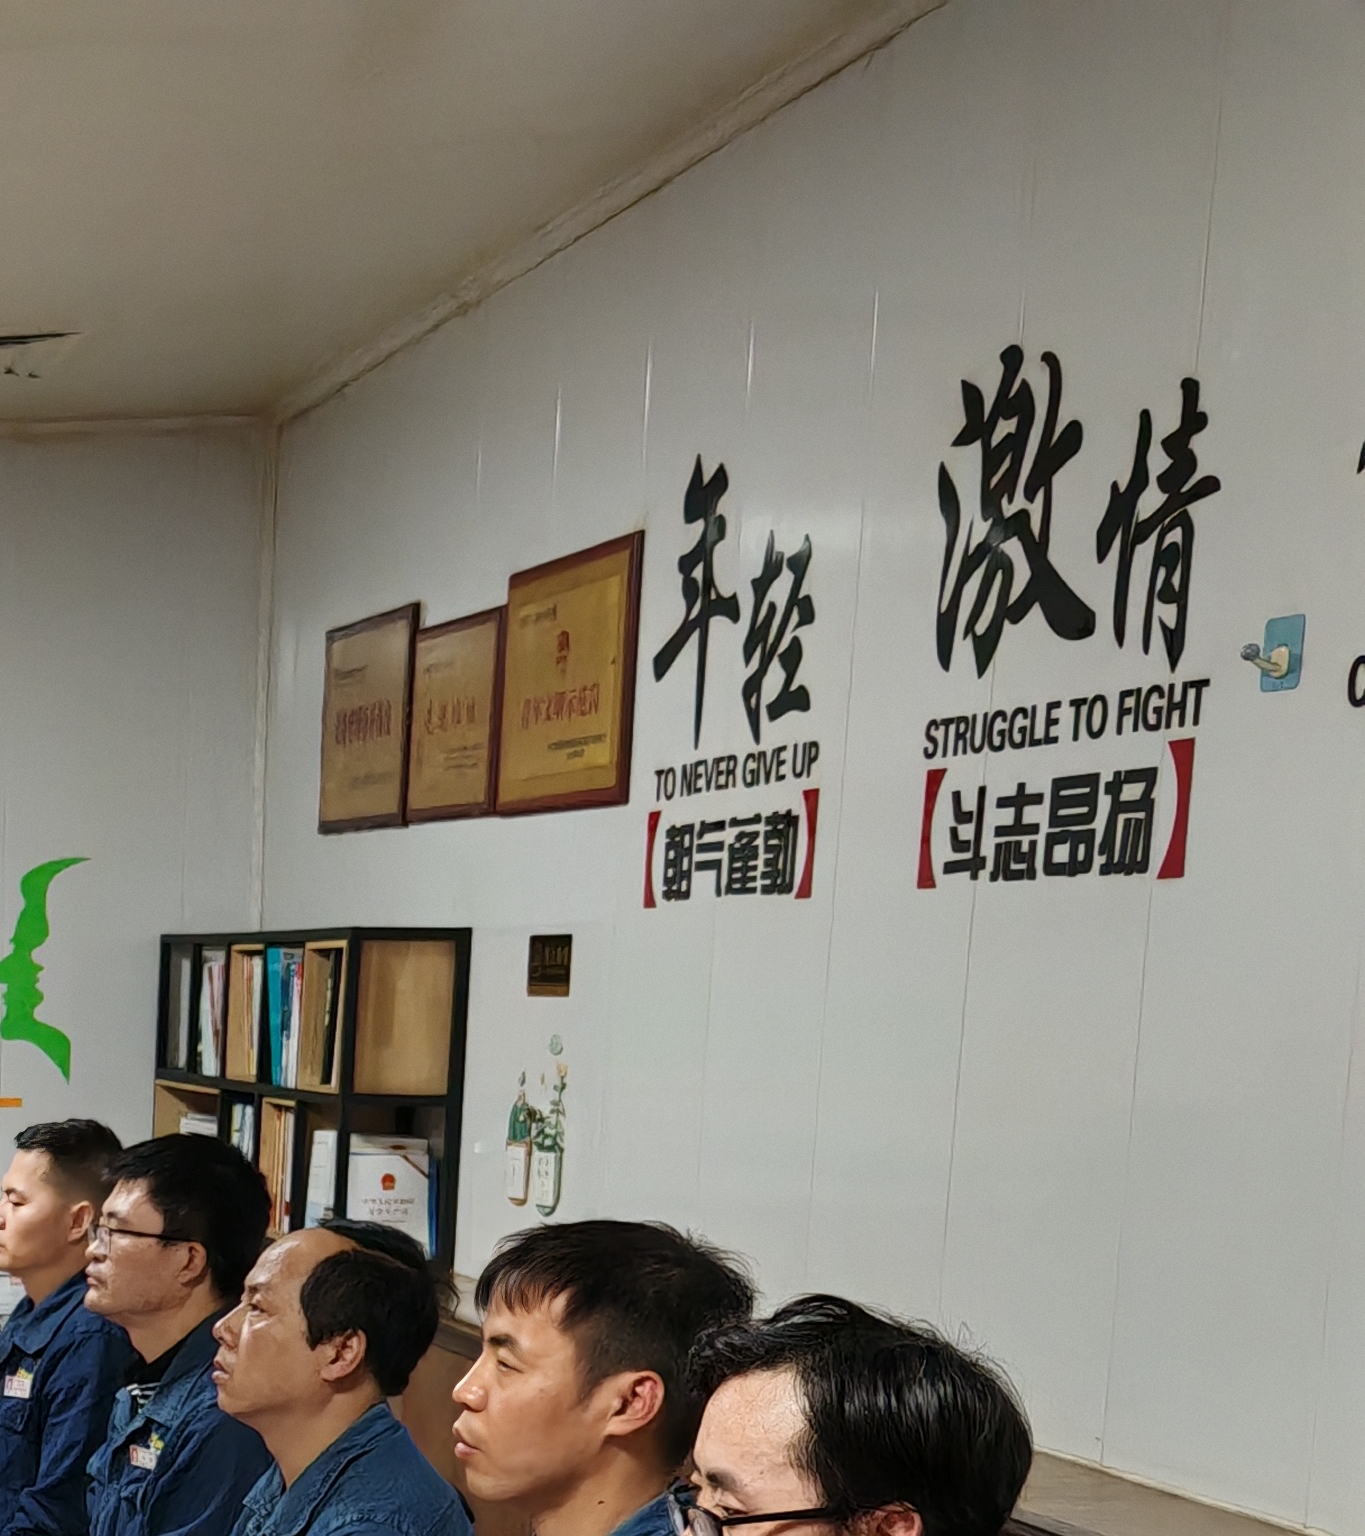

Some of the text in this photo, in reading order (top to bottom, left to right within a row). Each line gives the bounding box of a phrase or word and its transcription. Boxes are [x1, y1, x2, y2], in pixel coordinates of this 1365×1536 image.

[653, 453, 817, 749] 年轻
[936, 344, 1222, 679] 激情
[654, 740, 820, 802] TO NEVER GIVE UP
[923, 678, 1211, 760] STRUGGLE TO FIGHT
